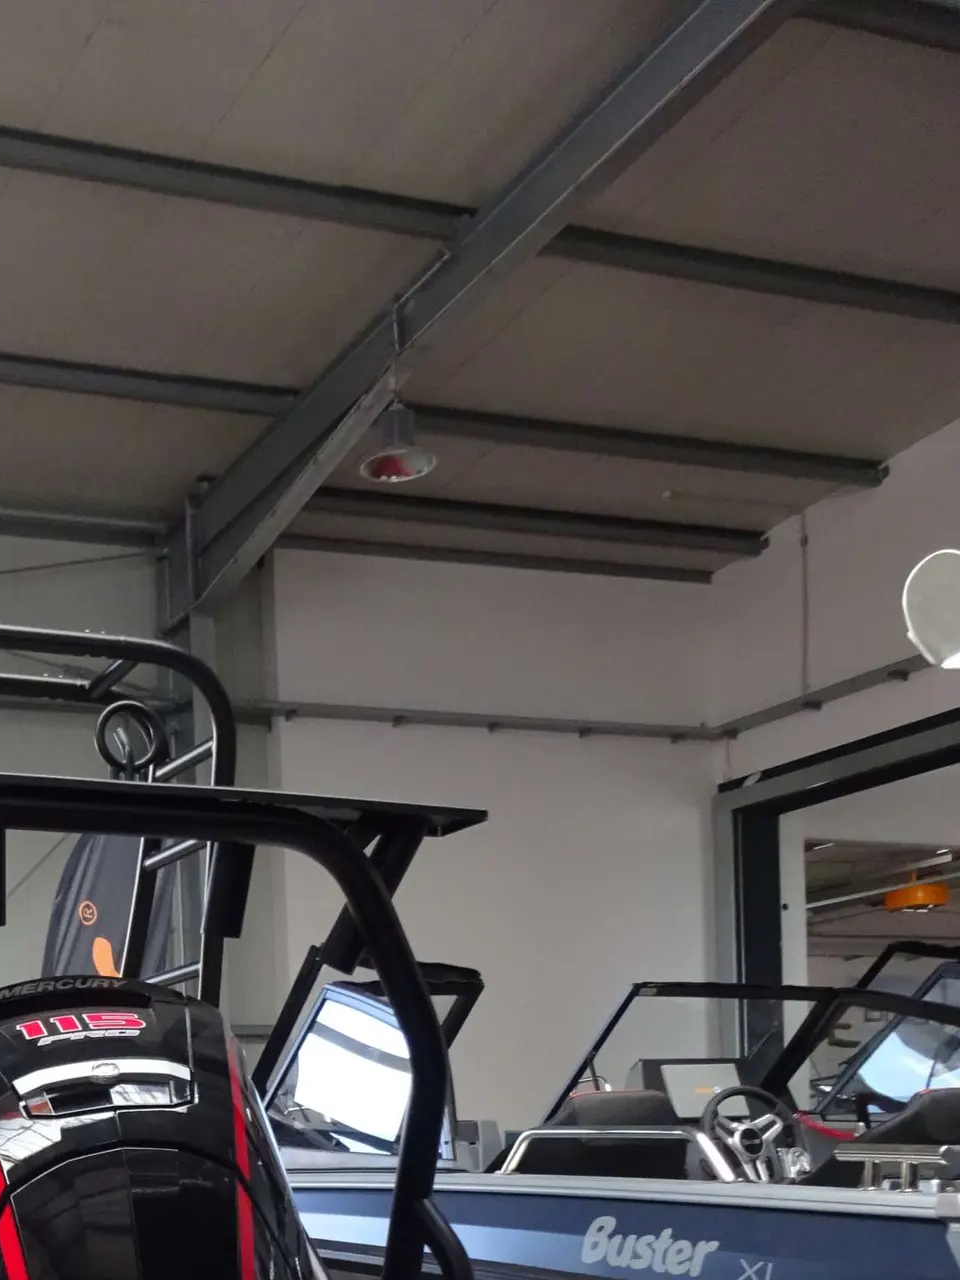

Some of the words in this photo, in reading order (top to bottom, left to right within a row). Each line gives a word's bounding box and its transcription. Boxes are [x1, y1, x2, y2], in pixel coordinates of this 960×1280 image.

[16, 1012, 147, 1040] 115
[37, 1029, 141, 1046] PRO
[581, 1215, 720, 1278] Buster
